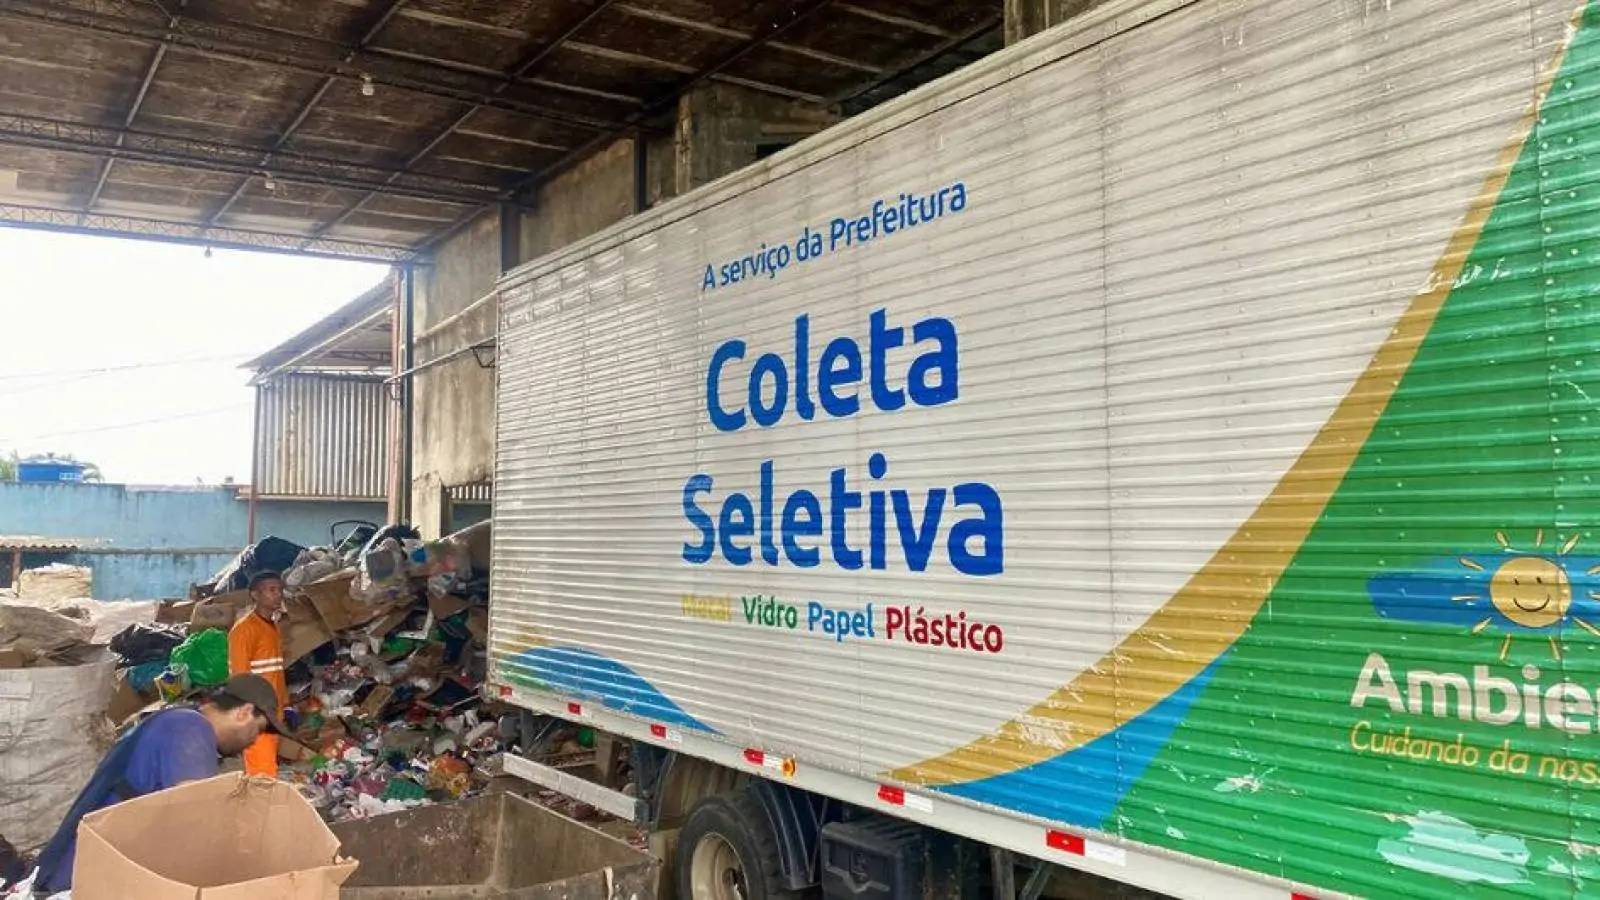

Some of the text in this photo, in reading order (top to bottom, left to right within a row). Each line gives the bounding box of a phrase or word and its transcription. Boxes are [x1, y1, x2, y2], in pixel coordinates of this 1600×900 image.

[702, 182, 967, 291] A serviço da Prefeitura
[706, 307, 959, 432] Coleta
[682, 452, 1004, 577] Seletiva
[742, 595, 798, 629] Vidro
[807, 602, 875, 642] Papel
[886, 606, 1004, 653] Plástico
[1350, 652, 1600, 735] Ambie
[1350, 721, 1600, 784] Cuidando da nos
